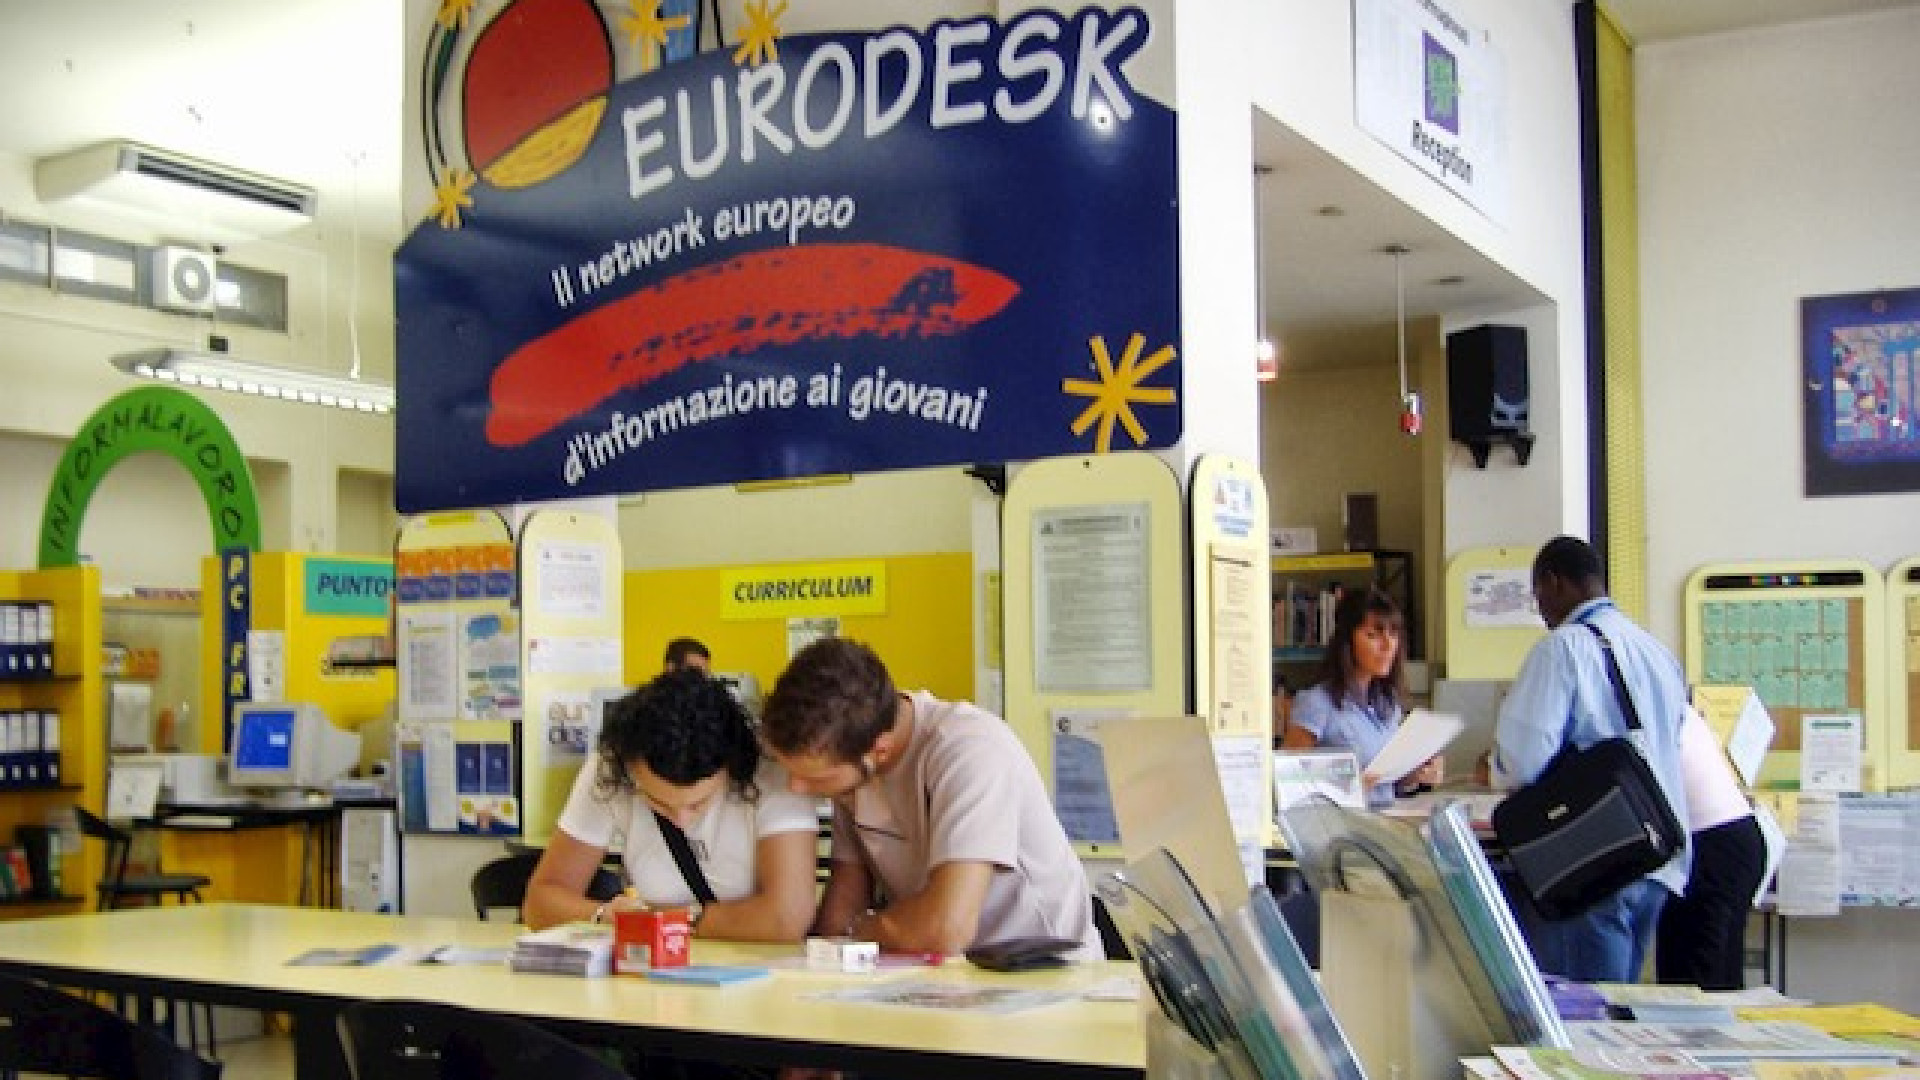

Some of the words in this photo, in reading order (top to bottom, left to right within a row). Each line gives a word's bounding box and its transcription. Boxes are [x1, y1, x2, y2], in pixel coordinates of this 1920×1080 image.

[622, 11, 1139, 198] EURODESK
[1412, 119, 1473, 185] Reception
[578, 206, 706, 294] network
[713, 195, 856, 247] europeo
[563, 371, 799, 486] d'informazione
[806, 362, 842, 407] ai
[848, 365, 989, 432] giovani
[227, 554, 245, 611] PC
[733, 575, 874, 604] CURRICULUM
